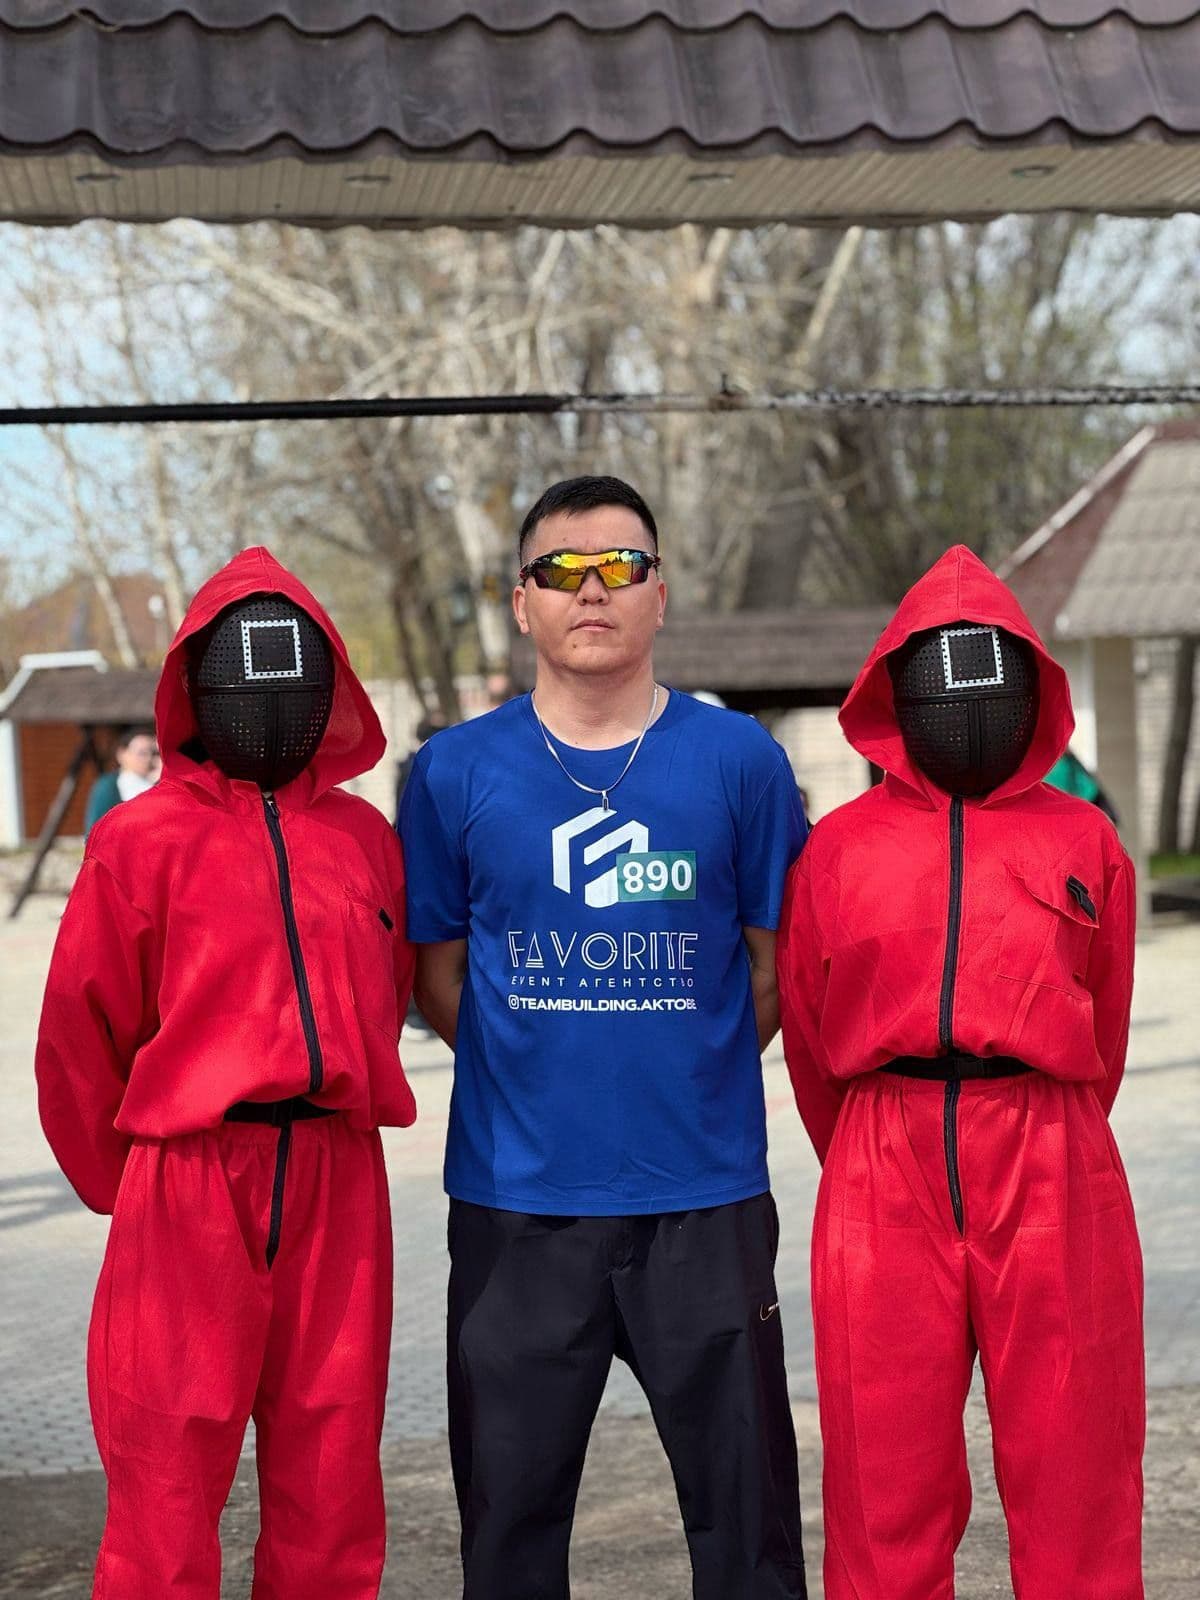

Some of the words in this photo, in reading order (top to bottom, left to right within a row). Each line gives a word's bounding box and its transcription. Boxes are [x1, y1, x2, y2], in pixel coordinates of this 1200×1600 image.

[622, 860, 692, 893] 890
[508, 931, 698, 970] FAVORITE
[511, 976, 566, 987] EVENT
